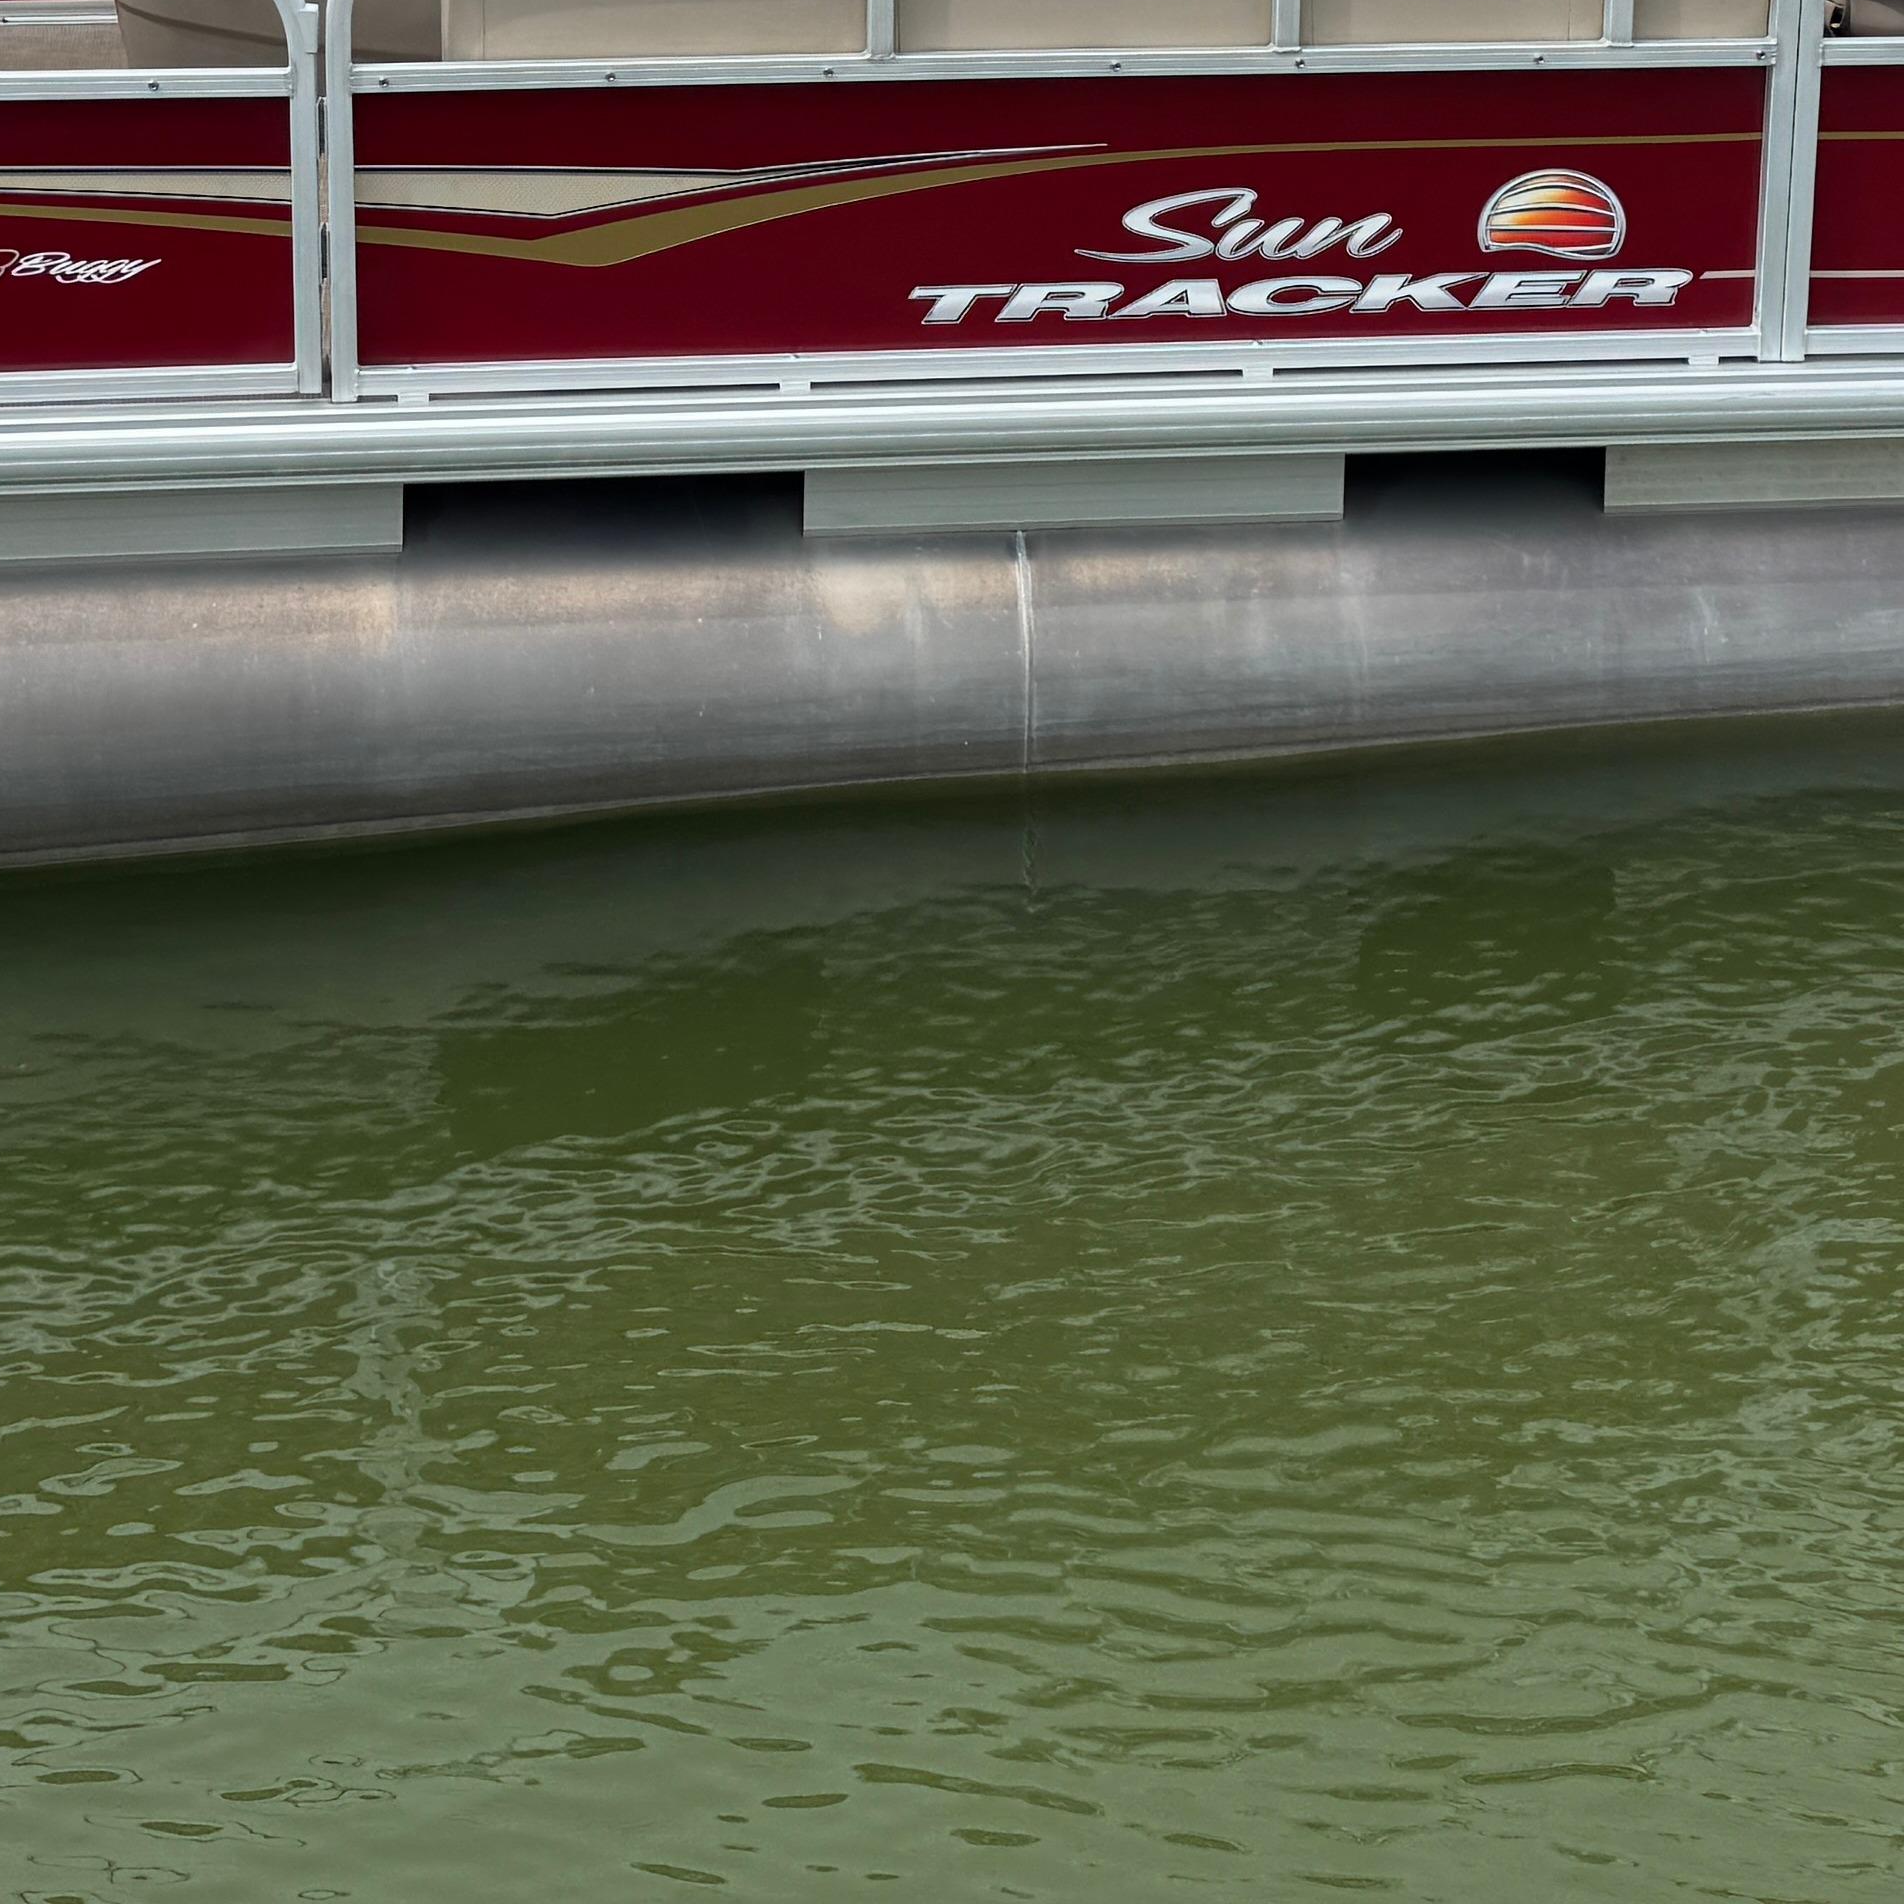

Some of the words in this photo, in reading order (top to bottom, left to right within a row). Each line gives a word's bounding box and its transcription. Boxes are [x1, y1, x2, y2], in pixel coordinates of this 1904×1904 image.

[1074, 187, 1403, 263] Sun
[10, 251, 162, 284] Buggy
[908, 269, 1694, 325] TRACKER
